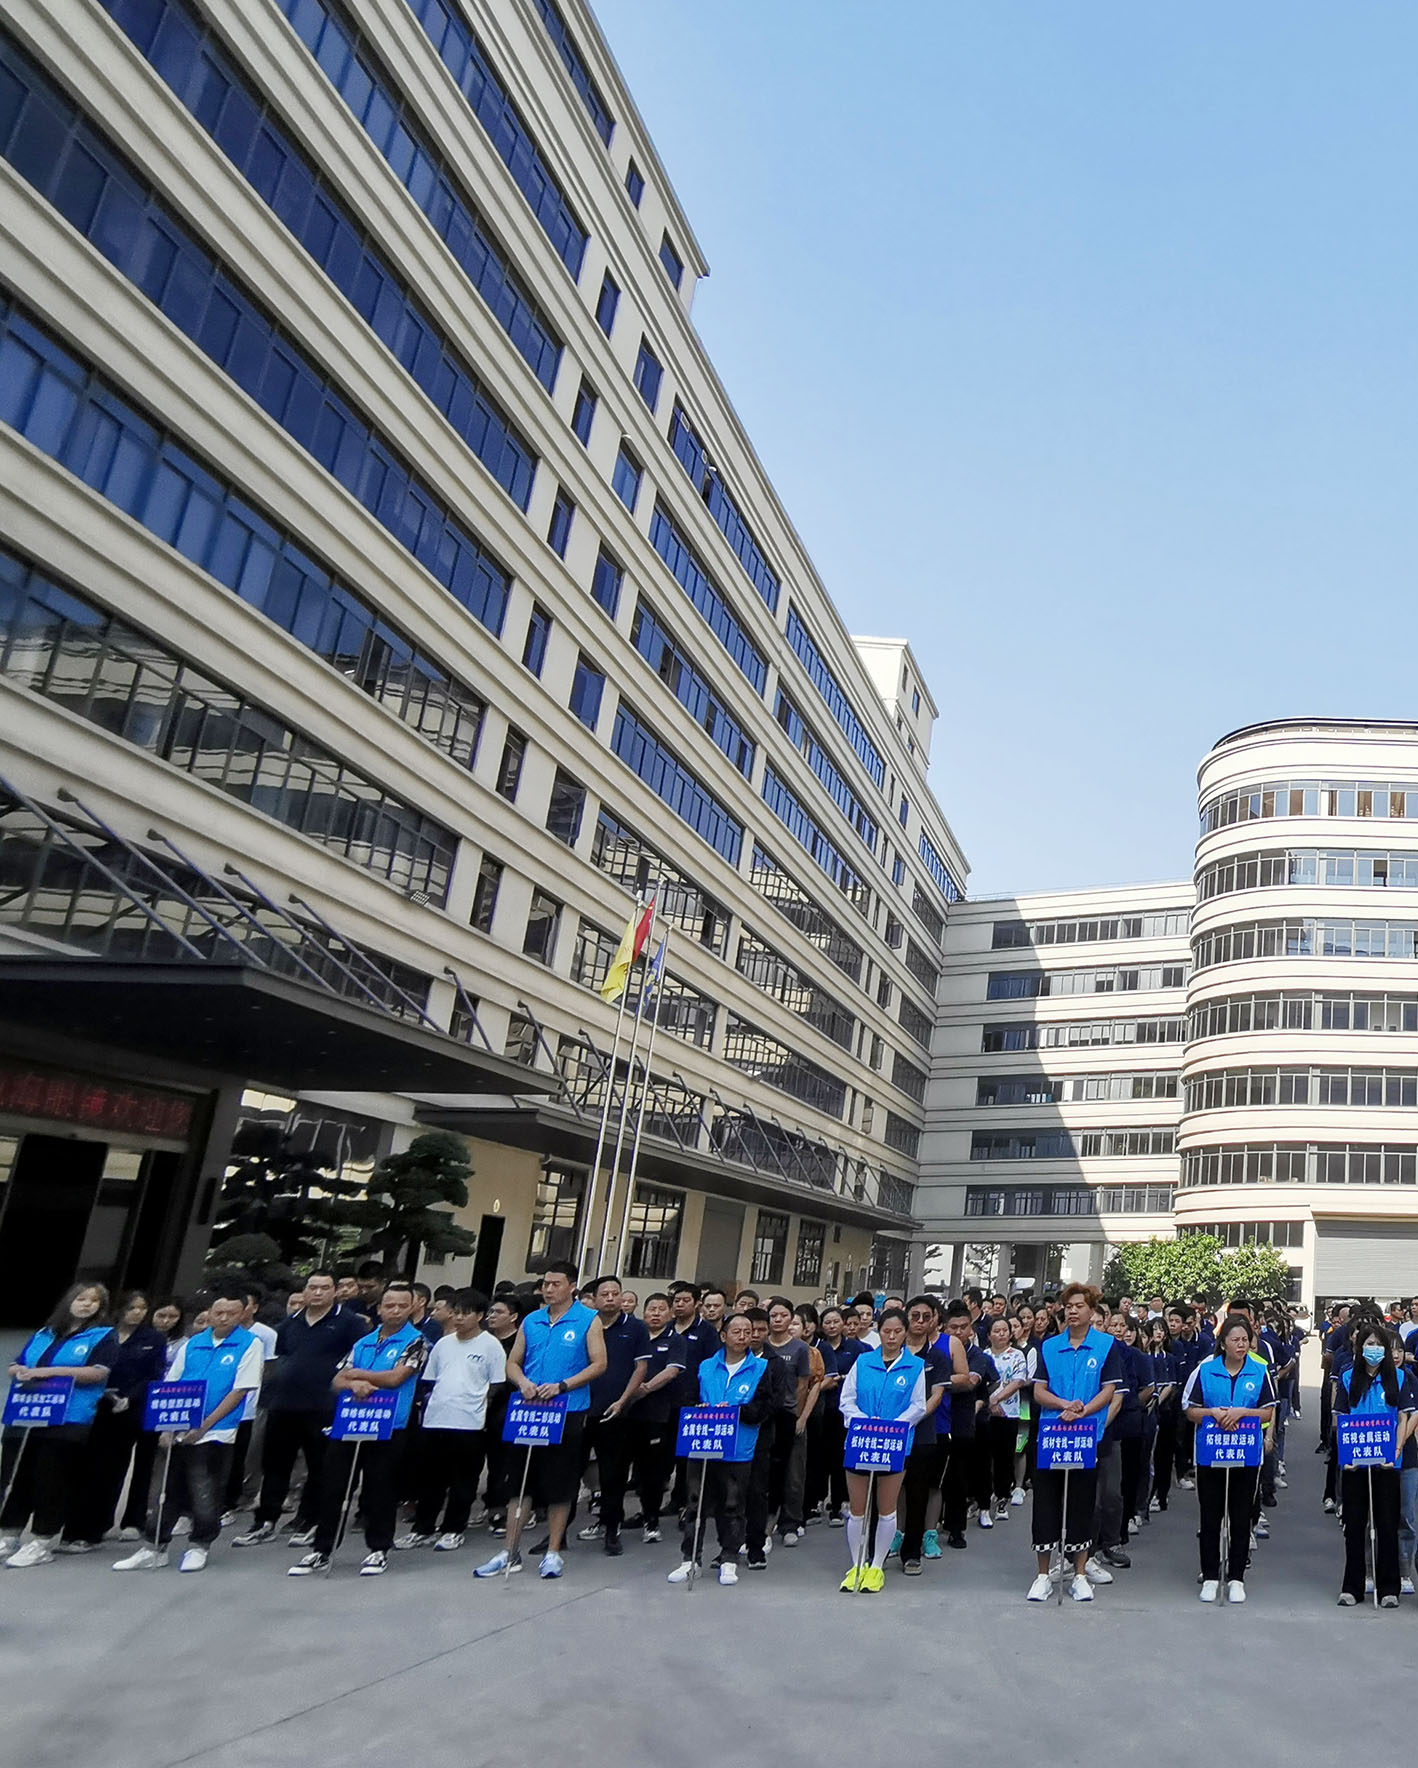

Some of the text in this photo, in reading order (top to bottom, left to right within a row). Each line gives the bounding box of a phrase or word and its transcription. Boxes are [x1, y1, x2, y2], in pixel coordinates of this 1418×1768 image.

[519, 1425, 549, 1438] 代表队
[683, 1424, 734, 1436] 金属专线一部运动
[1042, 1437, 1093, 1449] 板材专线一部运动
[1206, 1434, 1255, 1446] 拓视塑胶运动
[1343, 1431, 1390, 1444] 拓视金属运动
[692, 1439, 722, 1450] 代表队
[851, 1436, 903, 1452] 板材专线二部运动
[1052, 1451, 1083, 1462] 代表队
[1216, 1449, 1245, 1461] 代表队
[1353, 1446, 1383, 1457] 代表队
[859, 1451, 890, 1465] 代表队
